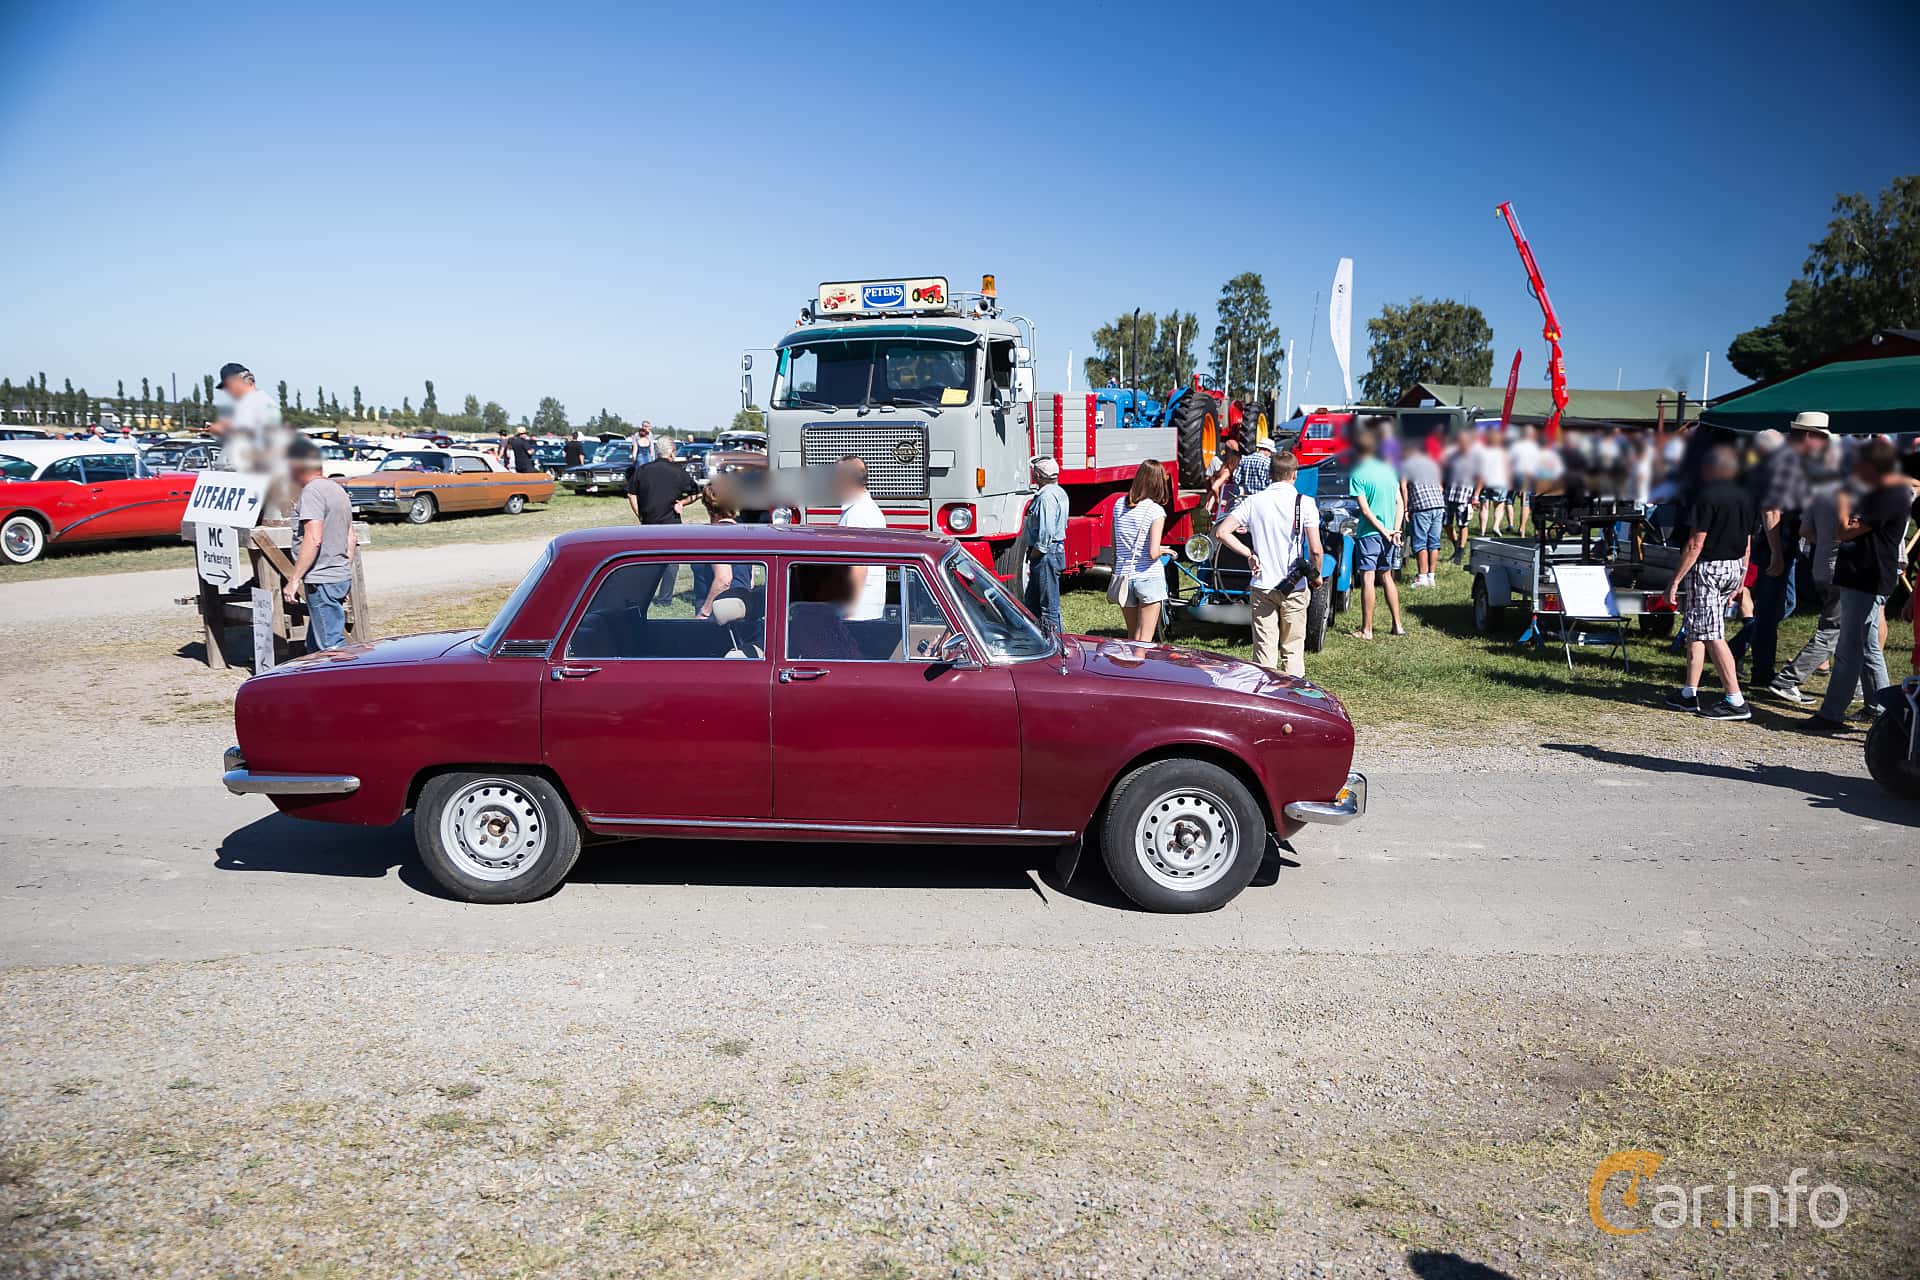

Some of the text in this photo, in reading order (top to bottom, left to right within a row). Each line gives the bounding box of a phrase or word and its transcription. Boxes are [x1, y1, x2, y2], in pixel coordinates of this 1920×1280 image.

[865, 287, 901, 297] PETERS
[193, 485, 246, 511] UTFART
[208, 527, 224, 548] MC
[203, 551, 232, 569] Parkering
